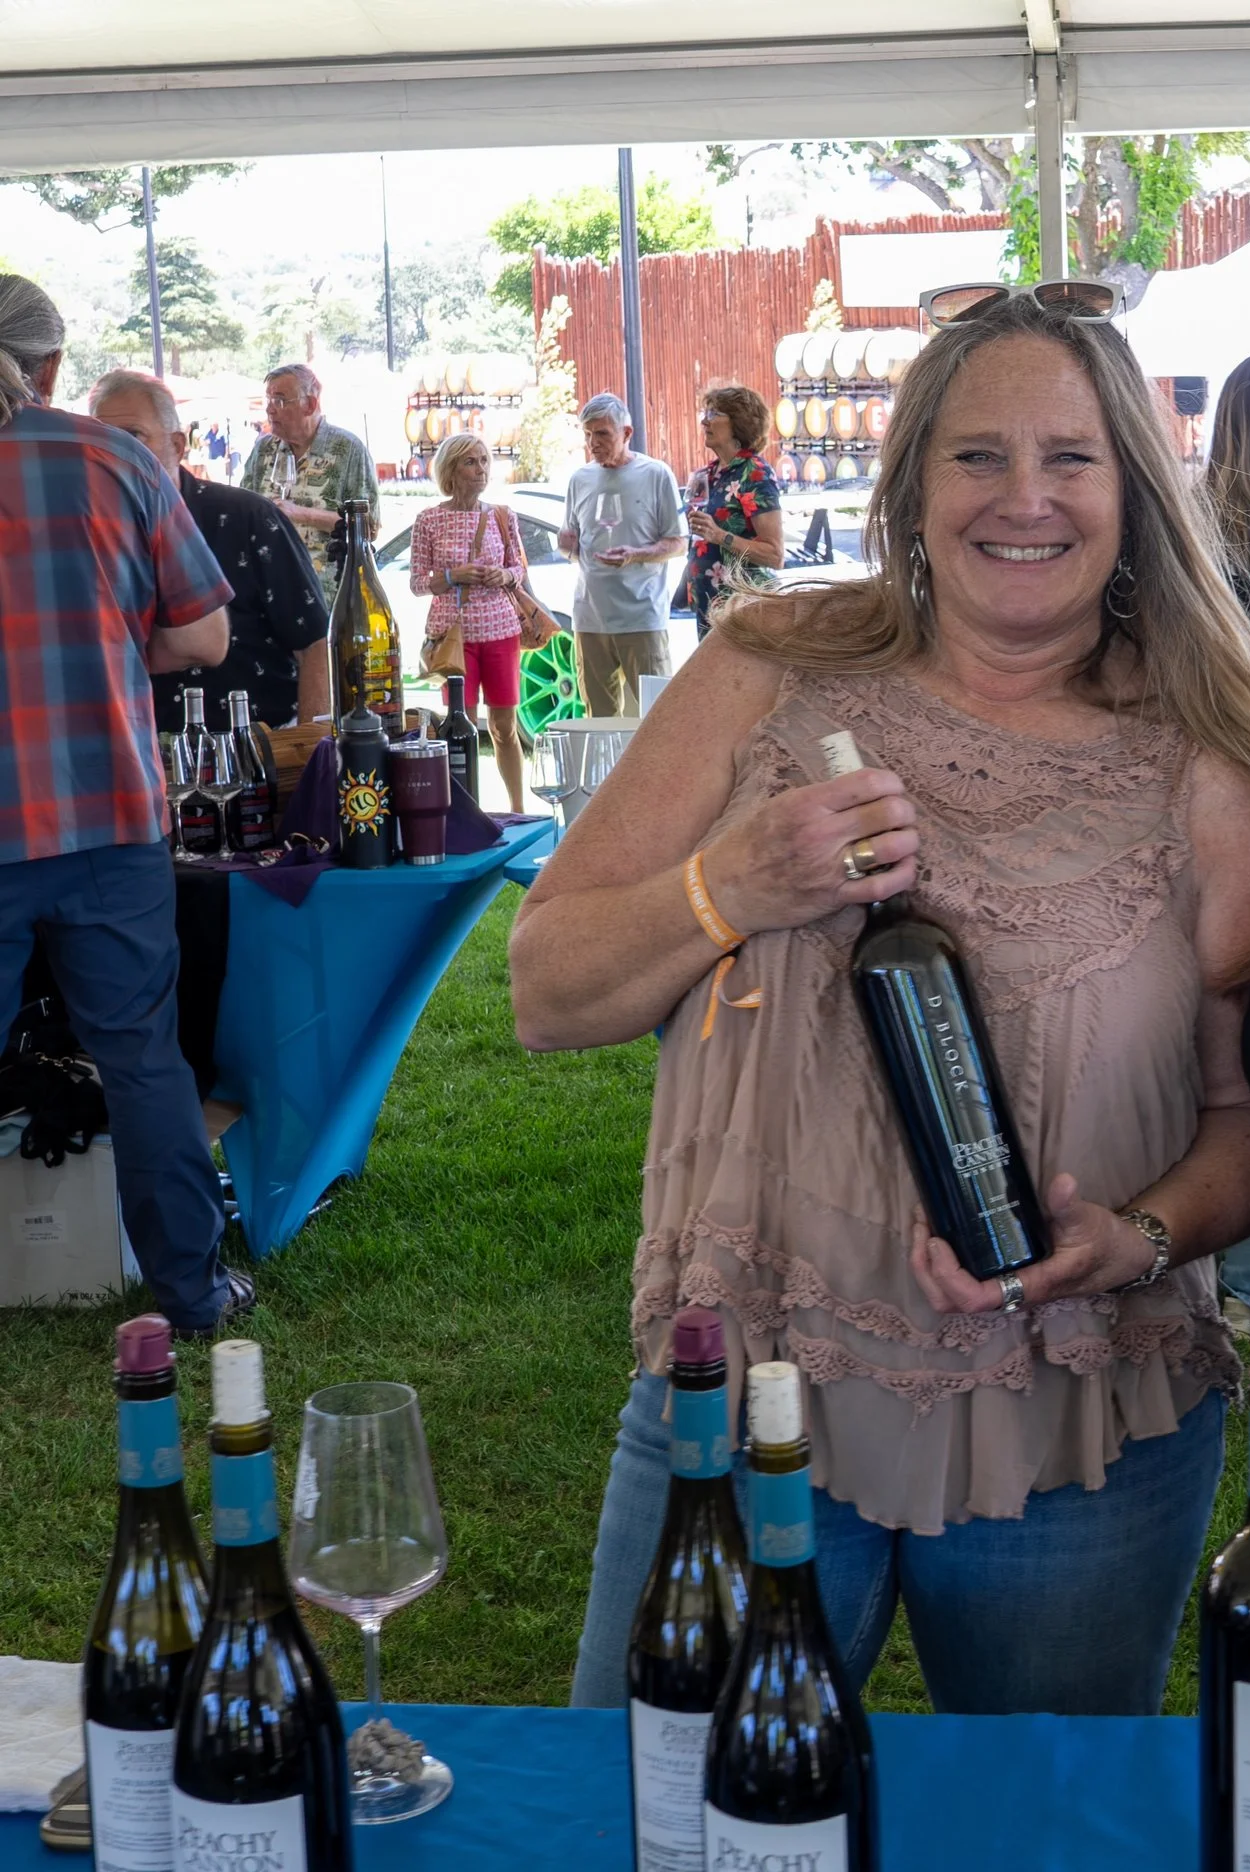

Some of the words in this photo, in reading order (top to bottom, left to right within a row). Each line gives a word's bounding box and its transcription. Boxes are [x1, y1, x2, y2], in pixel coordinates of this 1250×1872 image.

[348, 790, 377, 817] SLO
[928, 995, 943, 1008] D
[935, 1021, 970, 1093] BLOCK
[952, 1132, 1004, 1157] PEACHY
[952, 1143, 1011, 1170] CANYON
[713, 1835, 822, 1871] PEACHY
